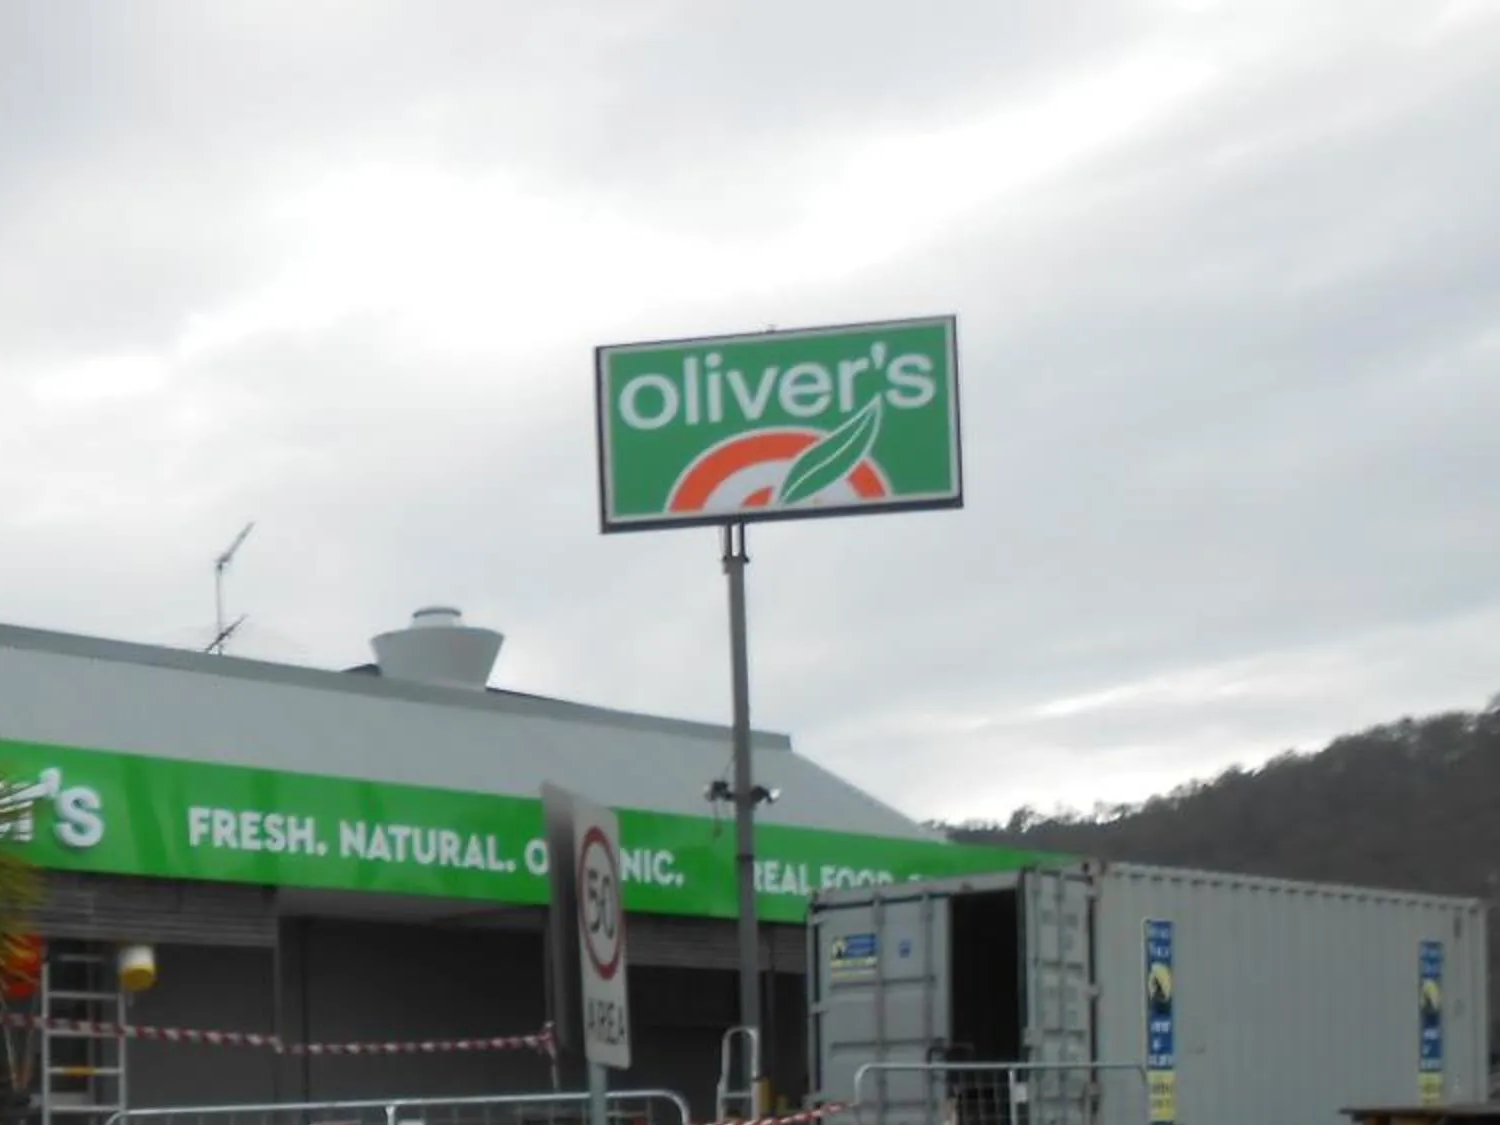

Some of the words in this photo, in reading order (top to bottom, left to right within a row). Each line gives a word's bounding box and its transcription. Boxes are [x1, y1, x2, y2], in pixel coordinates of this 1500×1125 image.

[618, 341, 936, 430] oliver's
[188, 806, 329, 857] FRESH.
[339, 820, 517, 873] NATURAL.
[525, 839, 684, 888] ONIC.
[586, 867, 616, 941] 50
